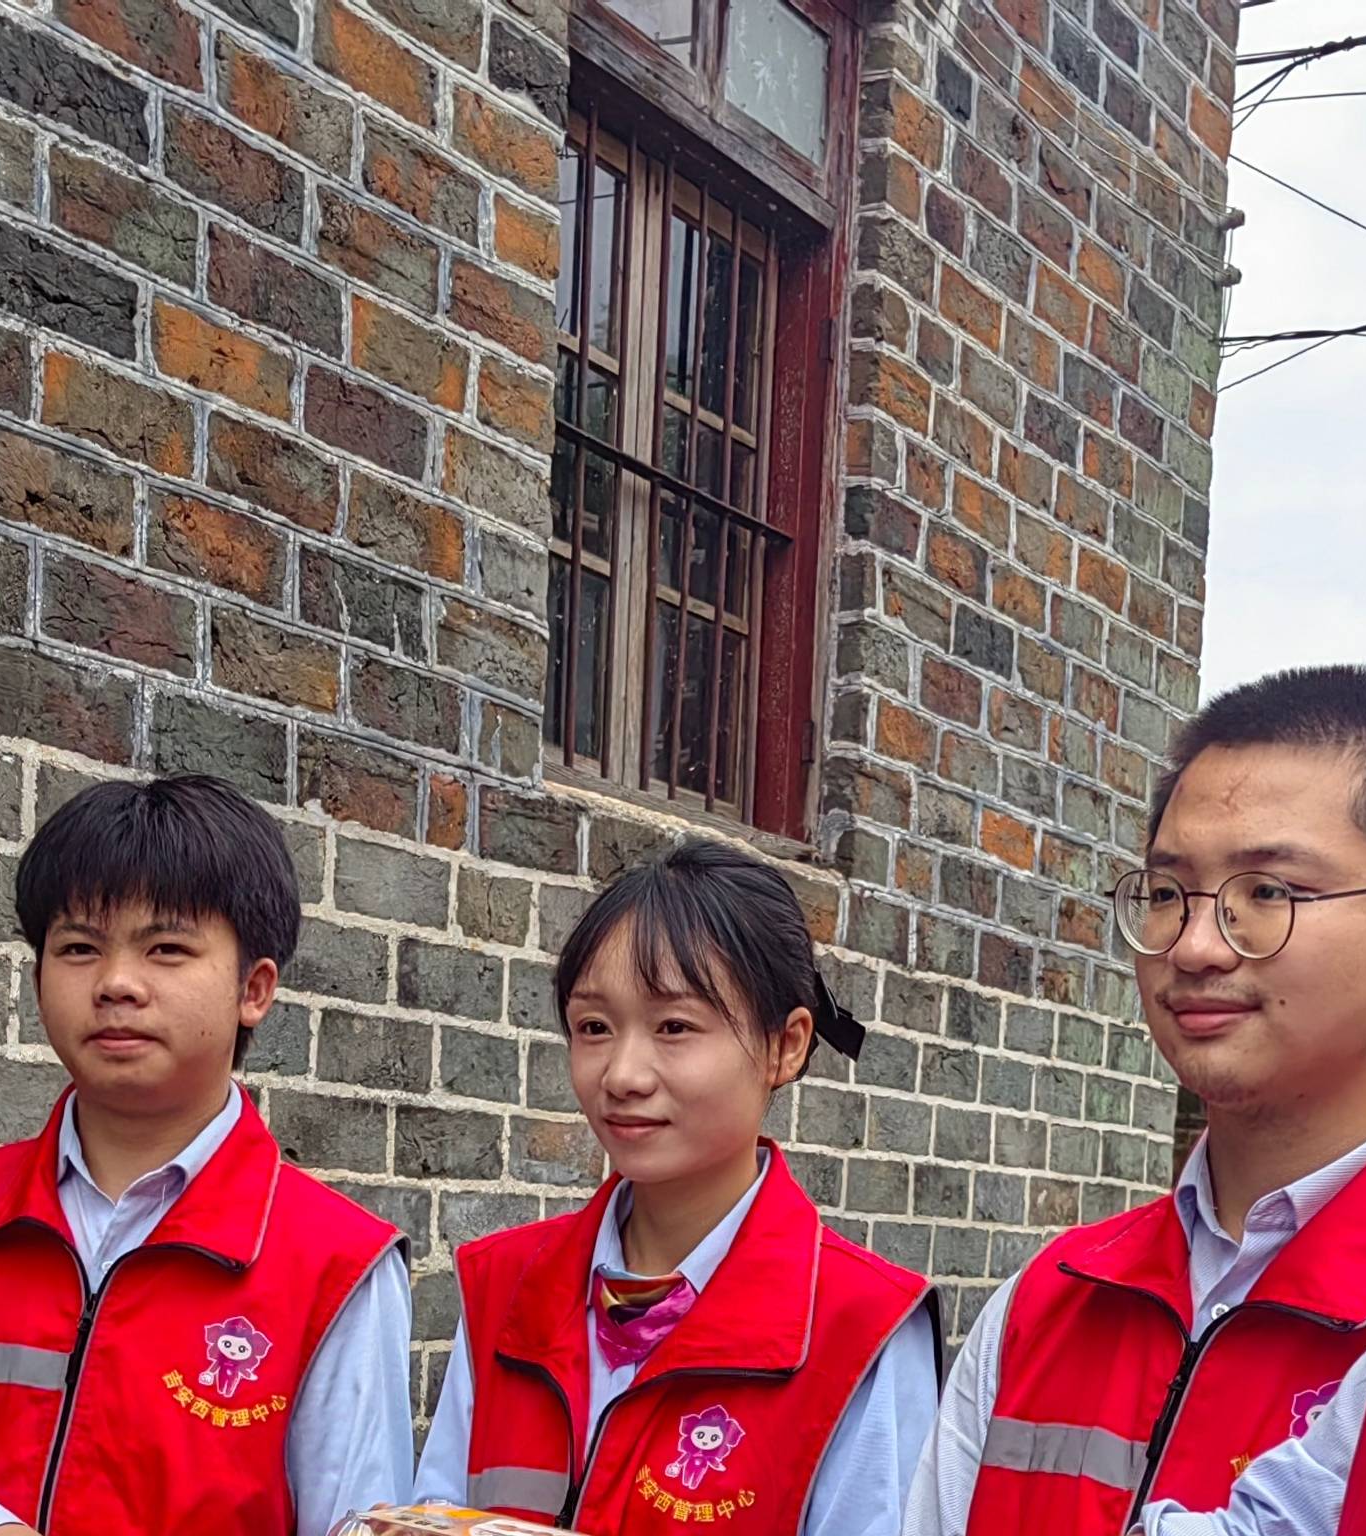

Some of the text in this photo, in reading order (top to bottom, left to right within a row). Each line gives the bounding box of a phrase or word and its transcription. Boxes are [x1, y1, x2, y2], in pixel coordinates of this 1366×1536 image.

[162, 1369, 287, 1428] 吉安西管理中心
